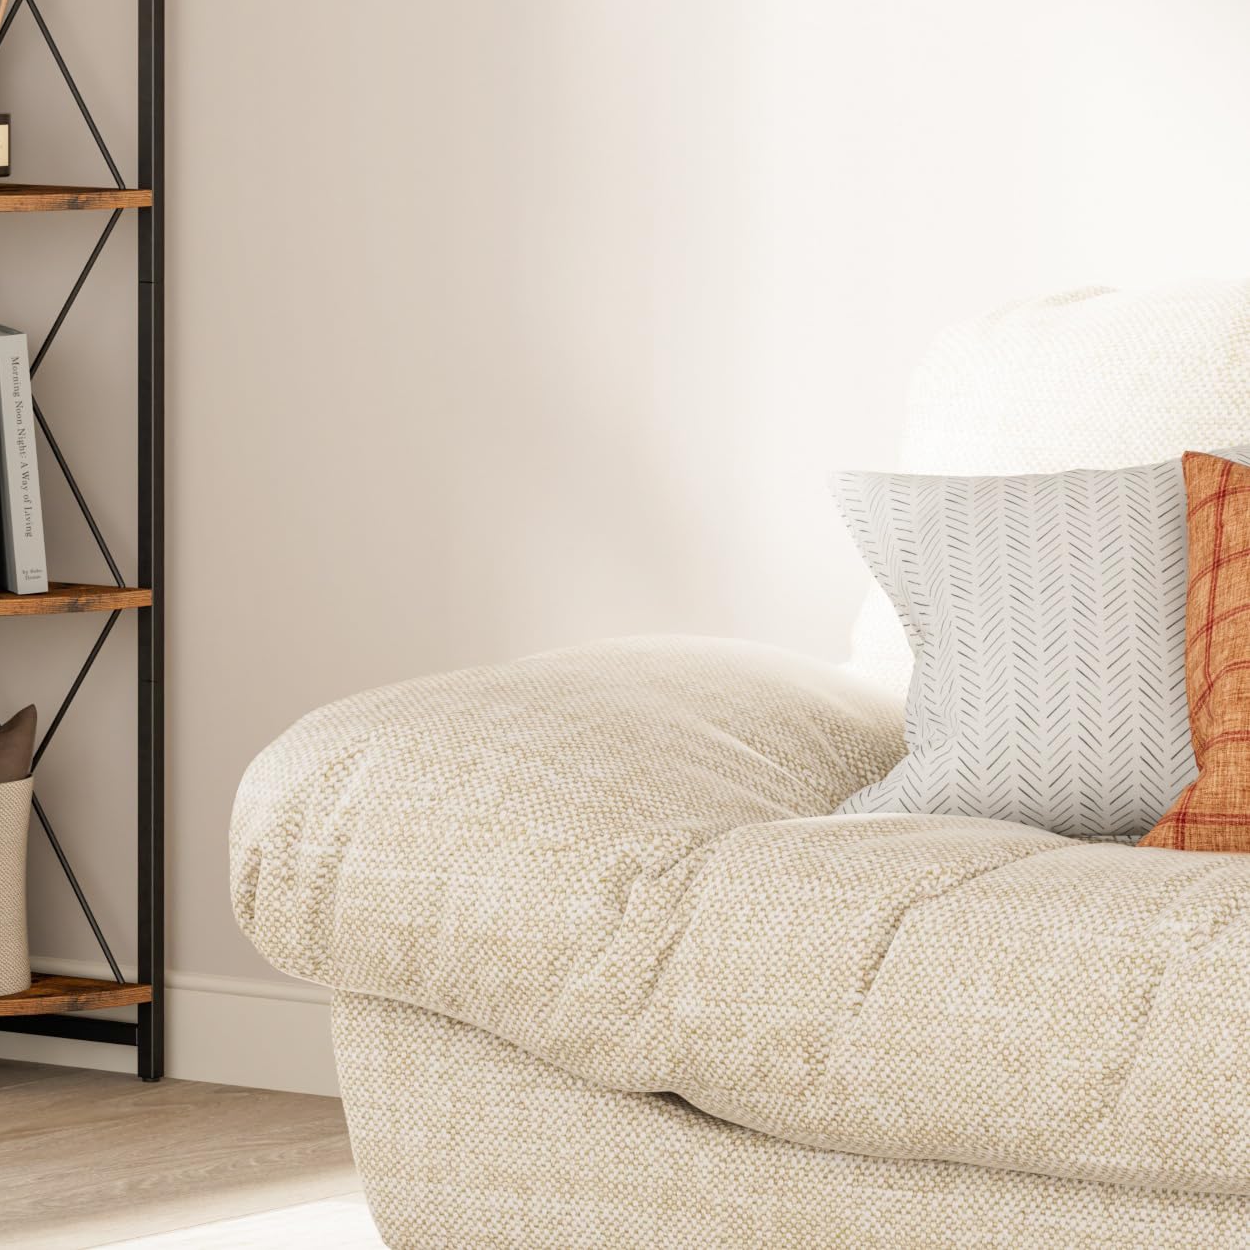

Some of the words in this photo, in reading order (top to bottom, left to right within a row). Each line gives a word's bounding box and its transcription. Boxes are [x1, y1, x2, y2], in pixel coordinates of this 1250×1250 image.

[11, 356, 22, 398] Morning
[15, 400, 24, 426] Noon
[20, 470, 30, 491] Way
[23, 494, 32, 504] of
[24, 506, 33, 538] Living
